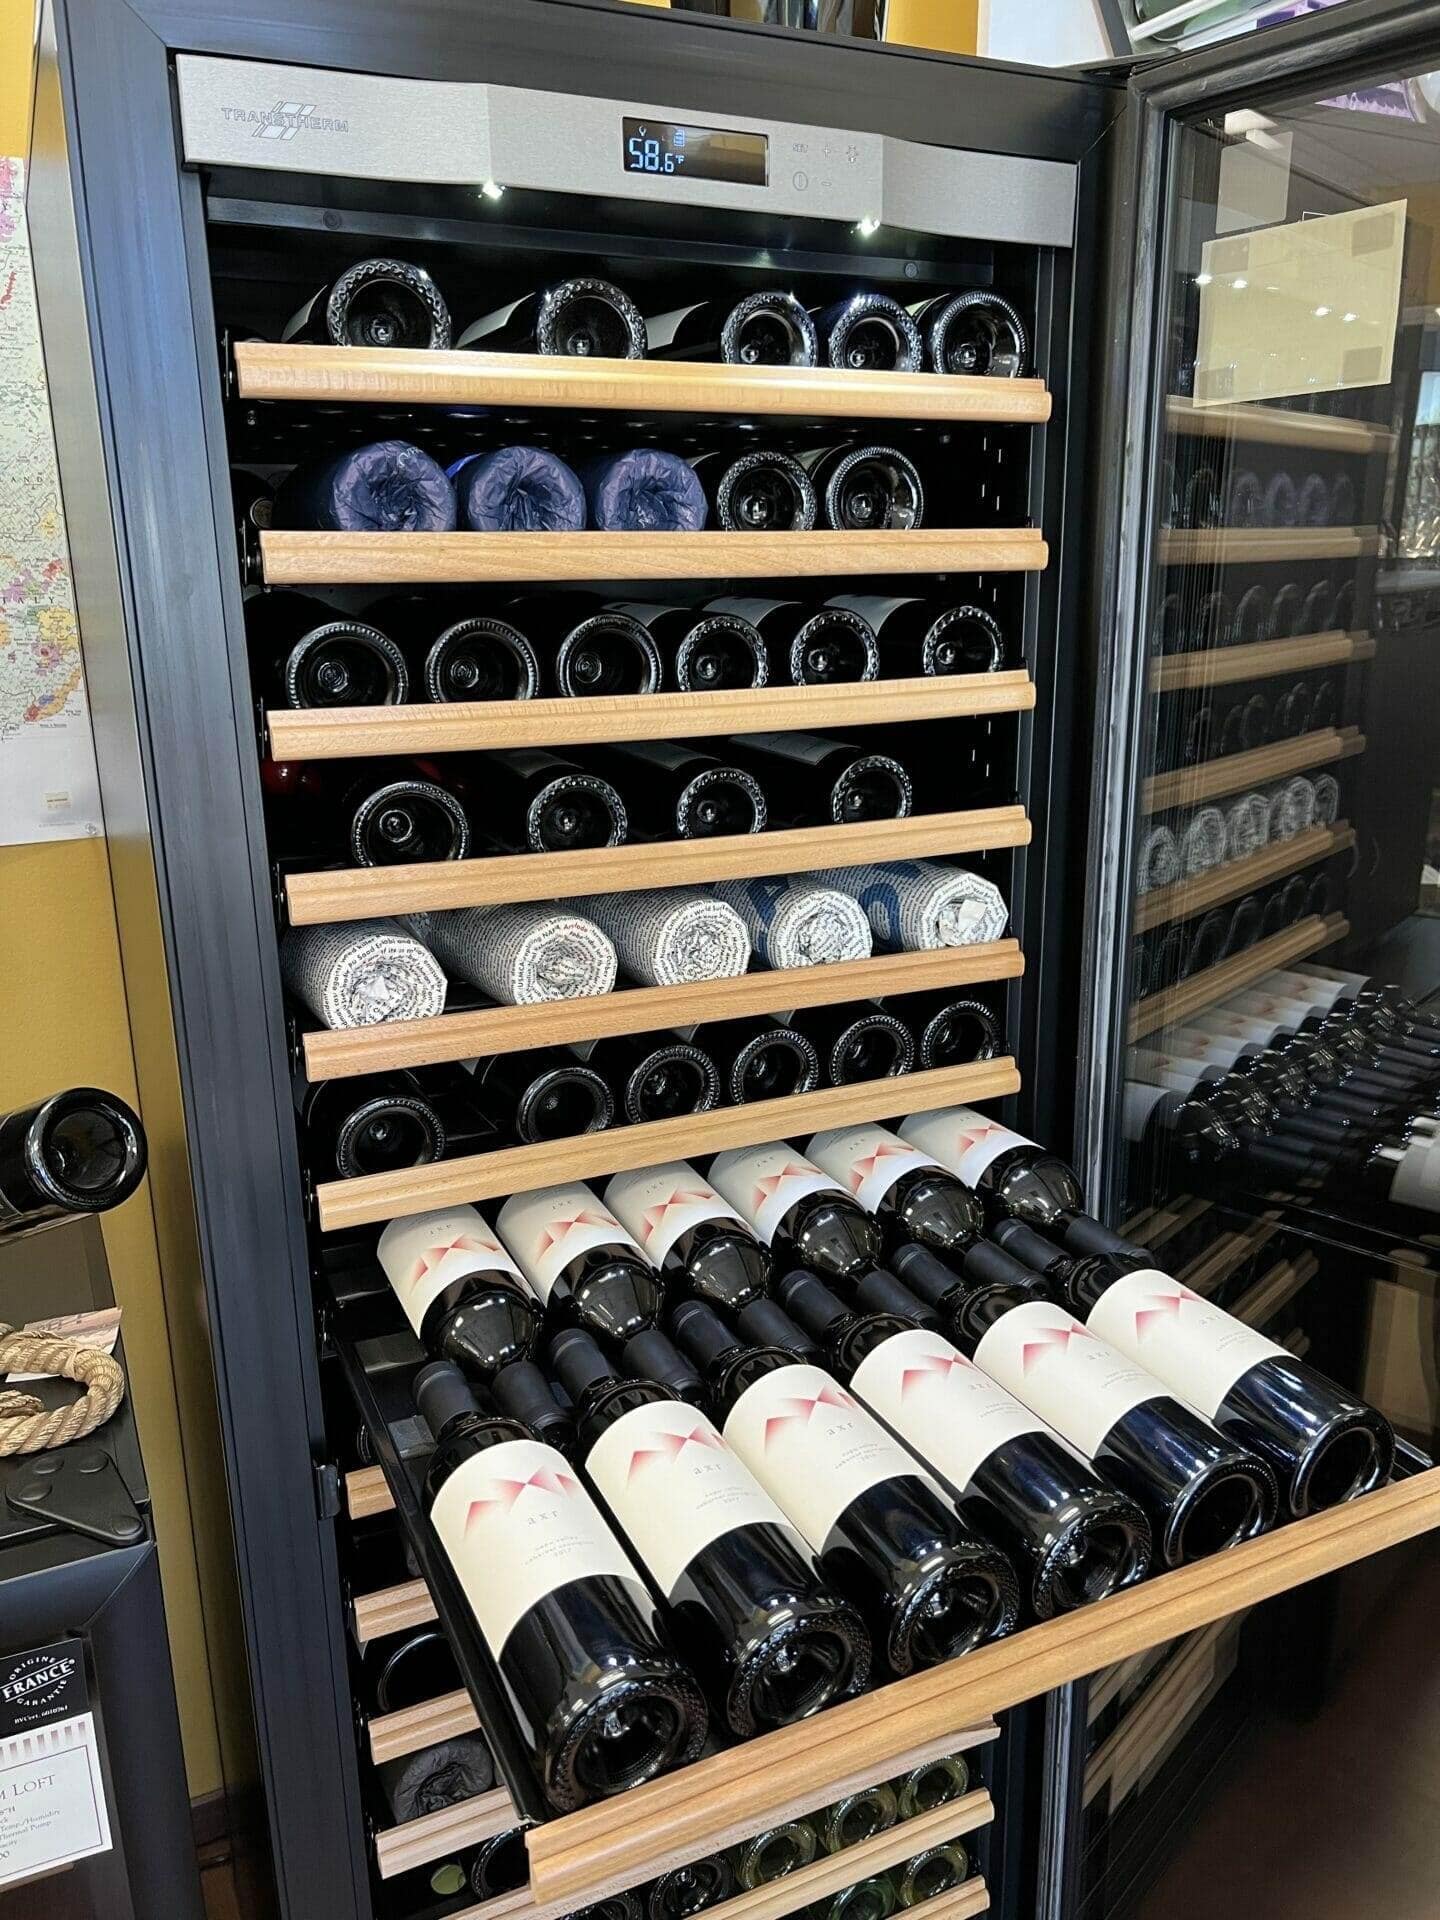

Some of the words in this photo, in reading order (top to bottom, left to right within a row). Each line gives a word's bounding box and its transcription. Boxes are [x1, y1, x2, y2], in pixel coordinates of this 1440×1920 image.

[221, 107, 349, 133] TRANSTHERM
[9, 1656, 56, 1680] ORIGINE
[17, 1680, 67, 1706] GARANTIE
